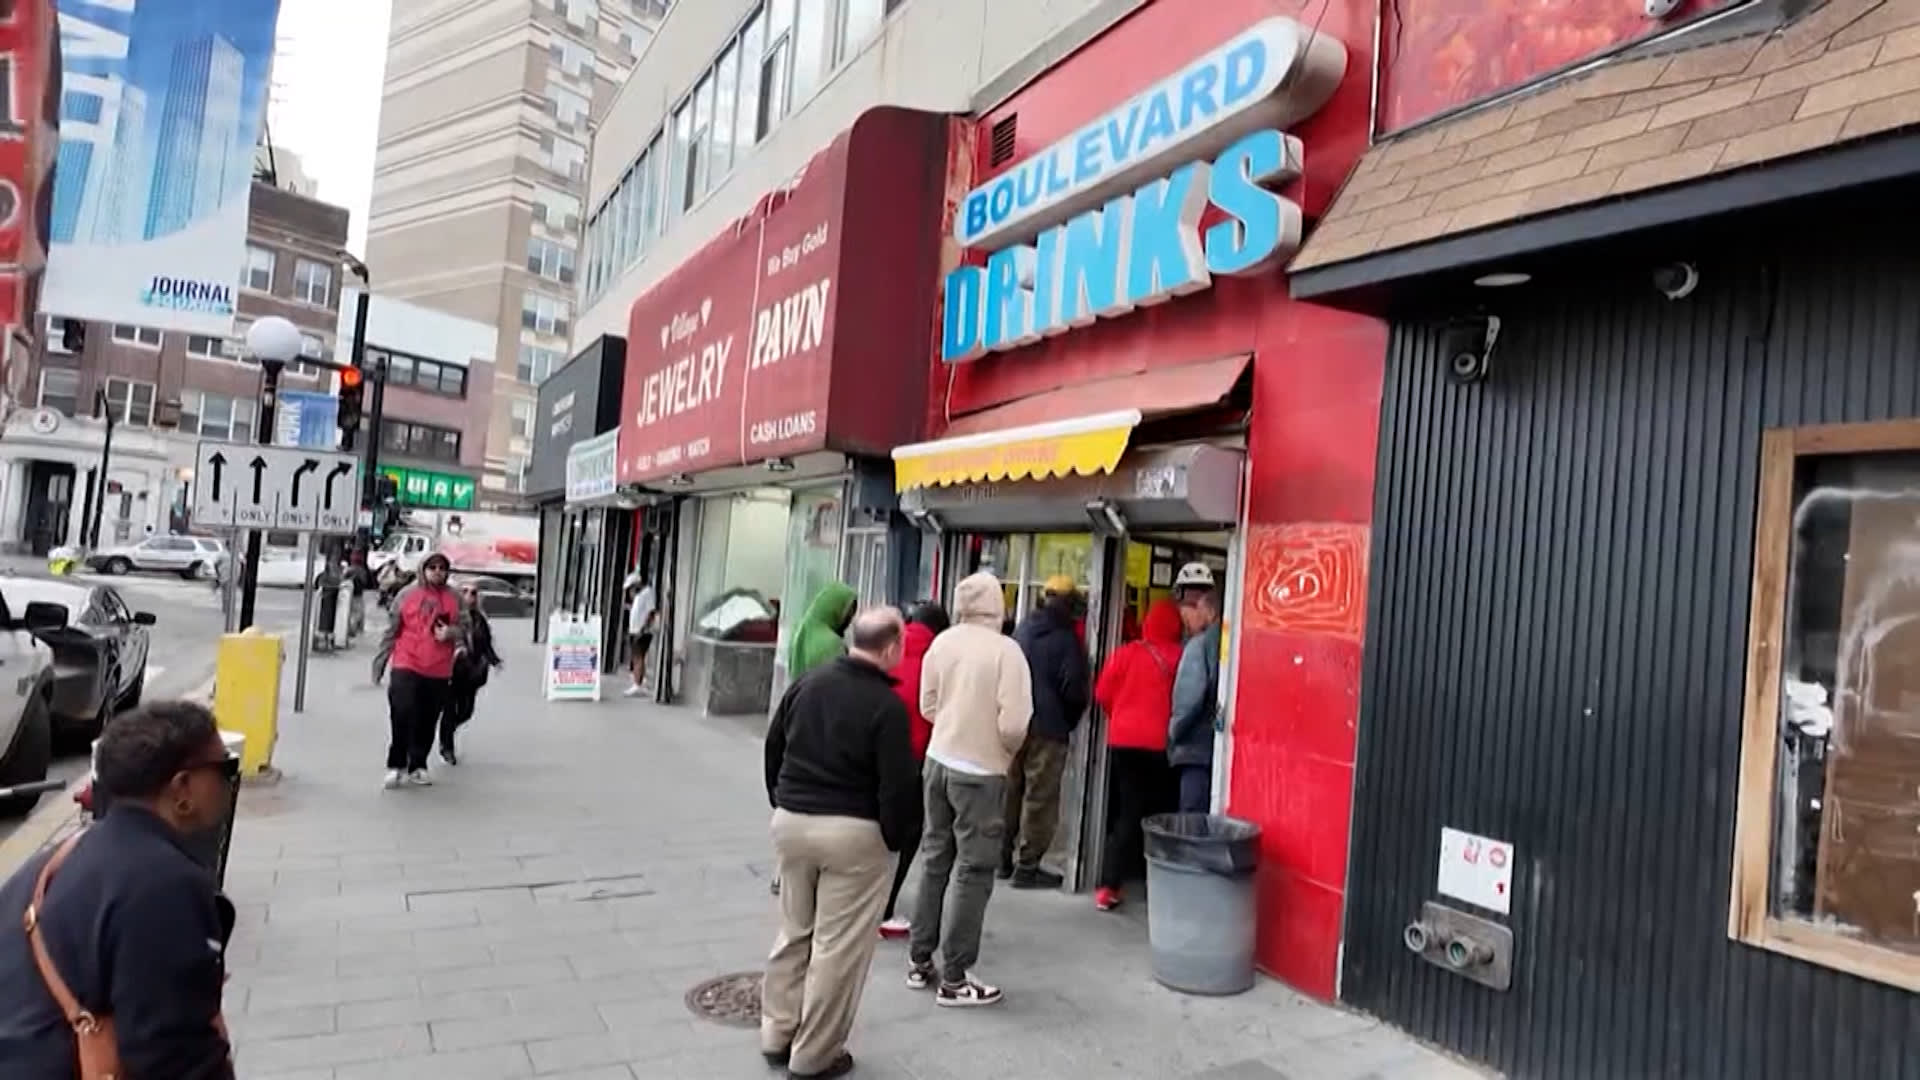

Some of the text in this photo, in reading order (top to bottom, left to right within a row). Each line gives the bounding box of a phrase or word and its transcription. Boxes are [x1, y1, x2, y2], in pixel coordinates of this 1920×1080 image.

[965, 39, 1267, 239] BOULEVARD
[151, 275, 232, 304] JOURNAL
[942, 129, 1287, 362] DRINKS
[751, 278, 831, 370] PAWN
[637, 335, 733, 428] JEWELRY
[750, 410, 817, 445] CASH LOANS
[240, 510, 272, 522] ONLY
[281, 512, 311, 525] ONLY
[322, 514, 350, 527] ONLY
